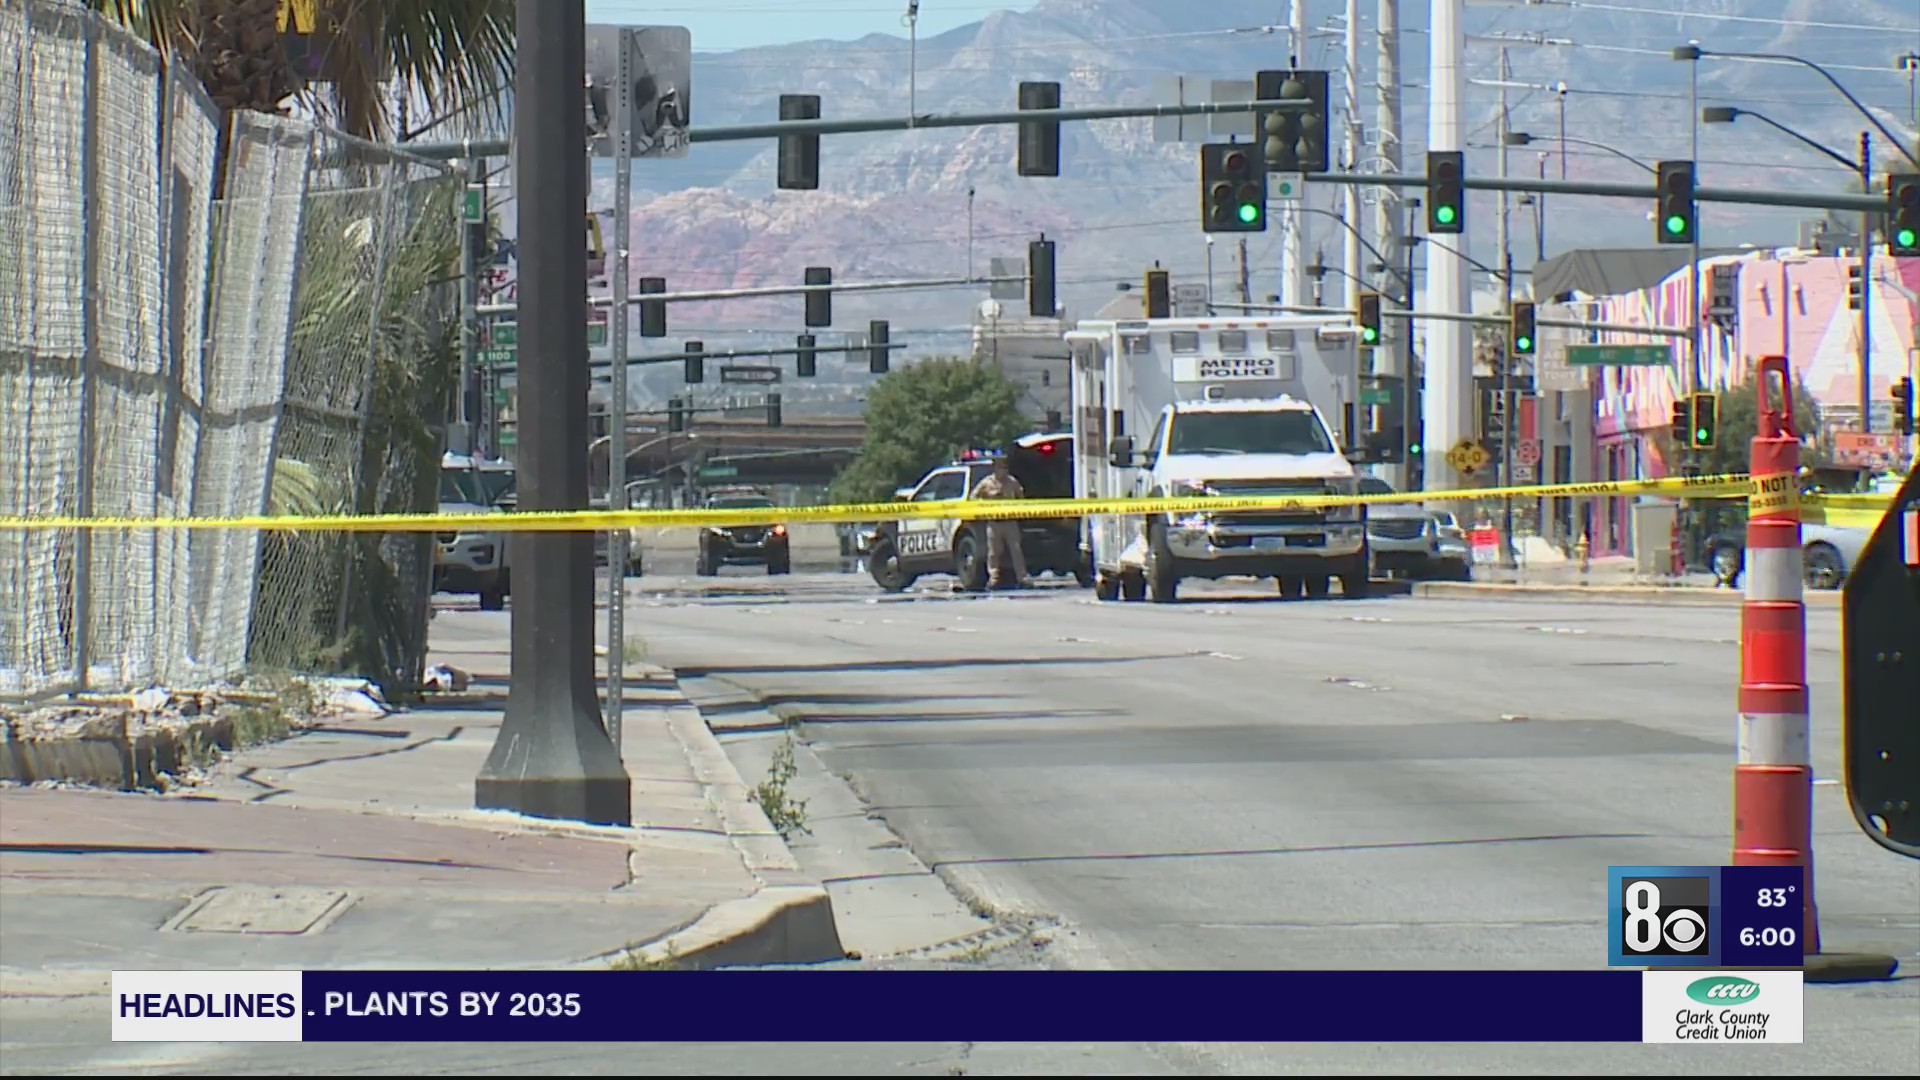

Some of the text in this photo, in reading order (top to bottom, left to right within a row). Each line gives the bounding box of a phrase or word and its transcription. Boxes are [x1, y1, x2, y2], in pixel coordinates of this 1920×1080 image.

[1200, 358, 1275, 368] METRO
[1200, 367, 1276, 378] POLICE
[1760, 476, 1787, 494] NOT
[900, 534, 937, 553] POLICE
